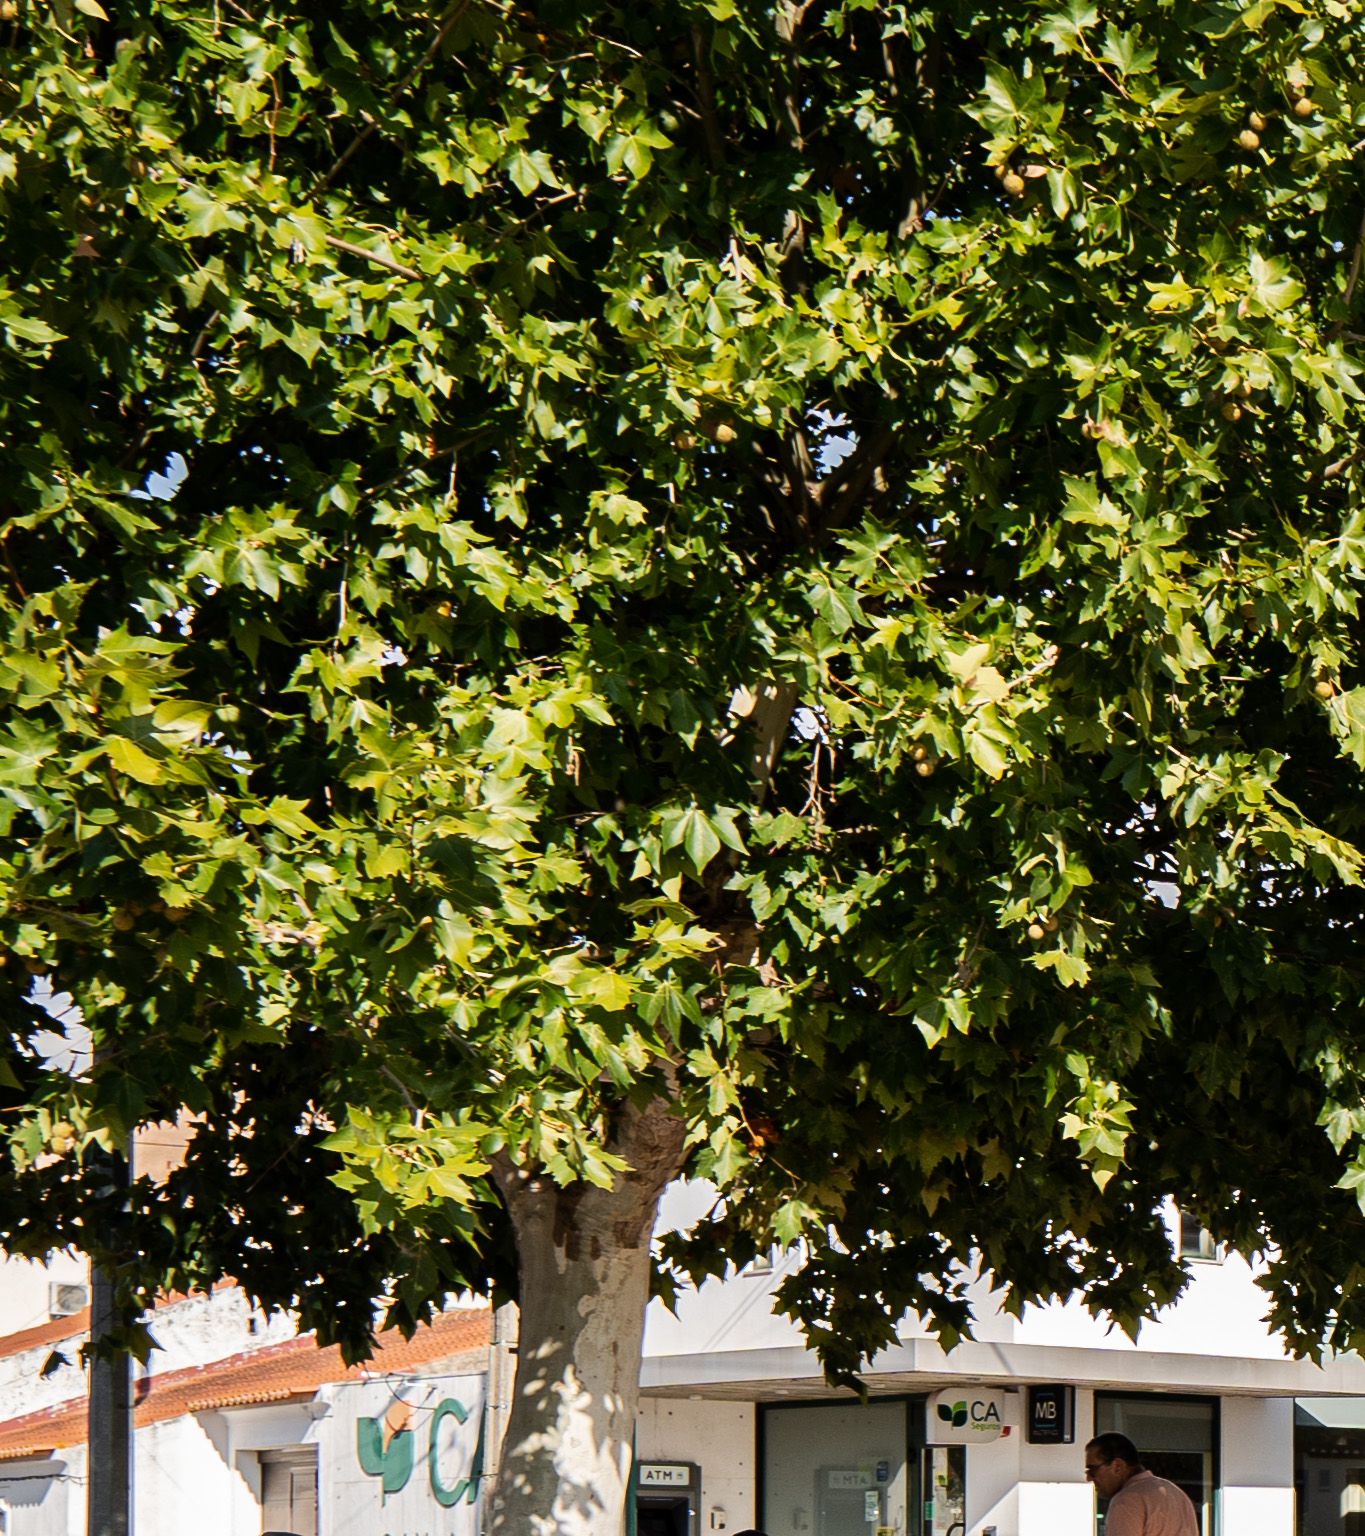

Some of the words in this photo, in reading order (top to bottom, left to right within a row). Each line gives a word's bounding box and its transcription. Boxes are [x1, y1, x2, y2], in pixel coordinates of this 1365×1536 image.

[970, 1400, 1000, 1422] CA
[1035, 1401, 1057, 1420] MB
[645, 1470, 673, 1481] ATM
